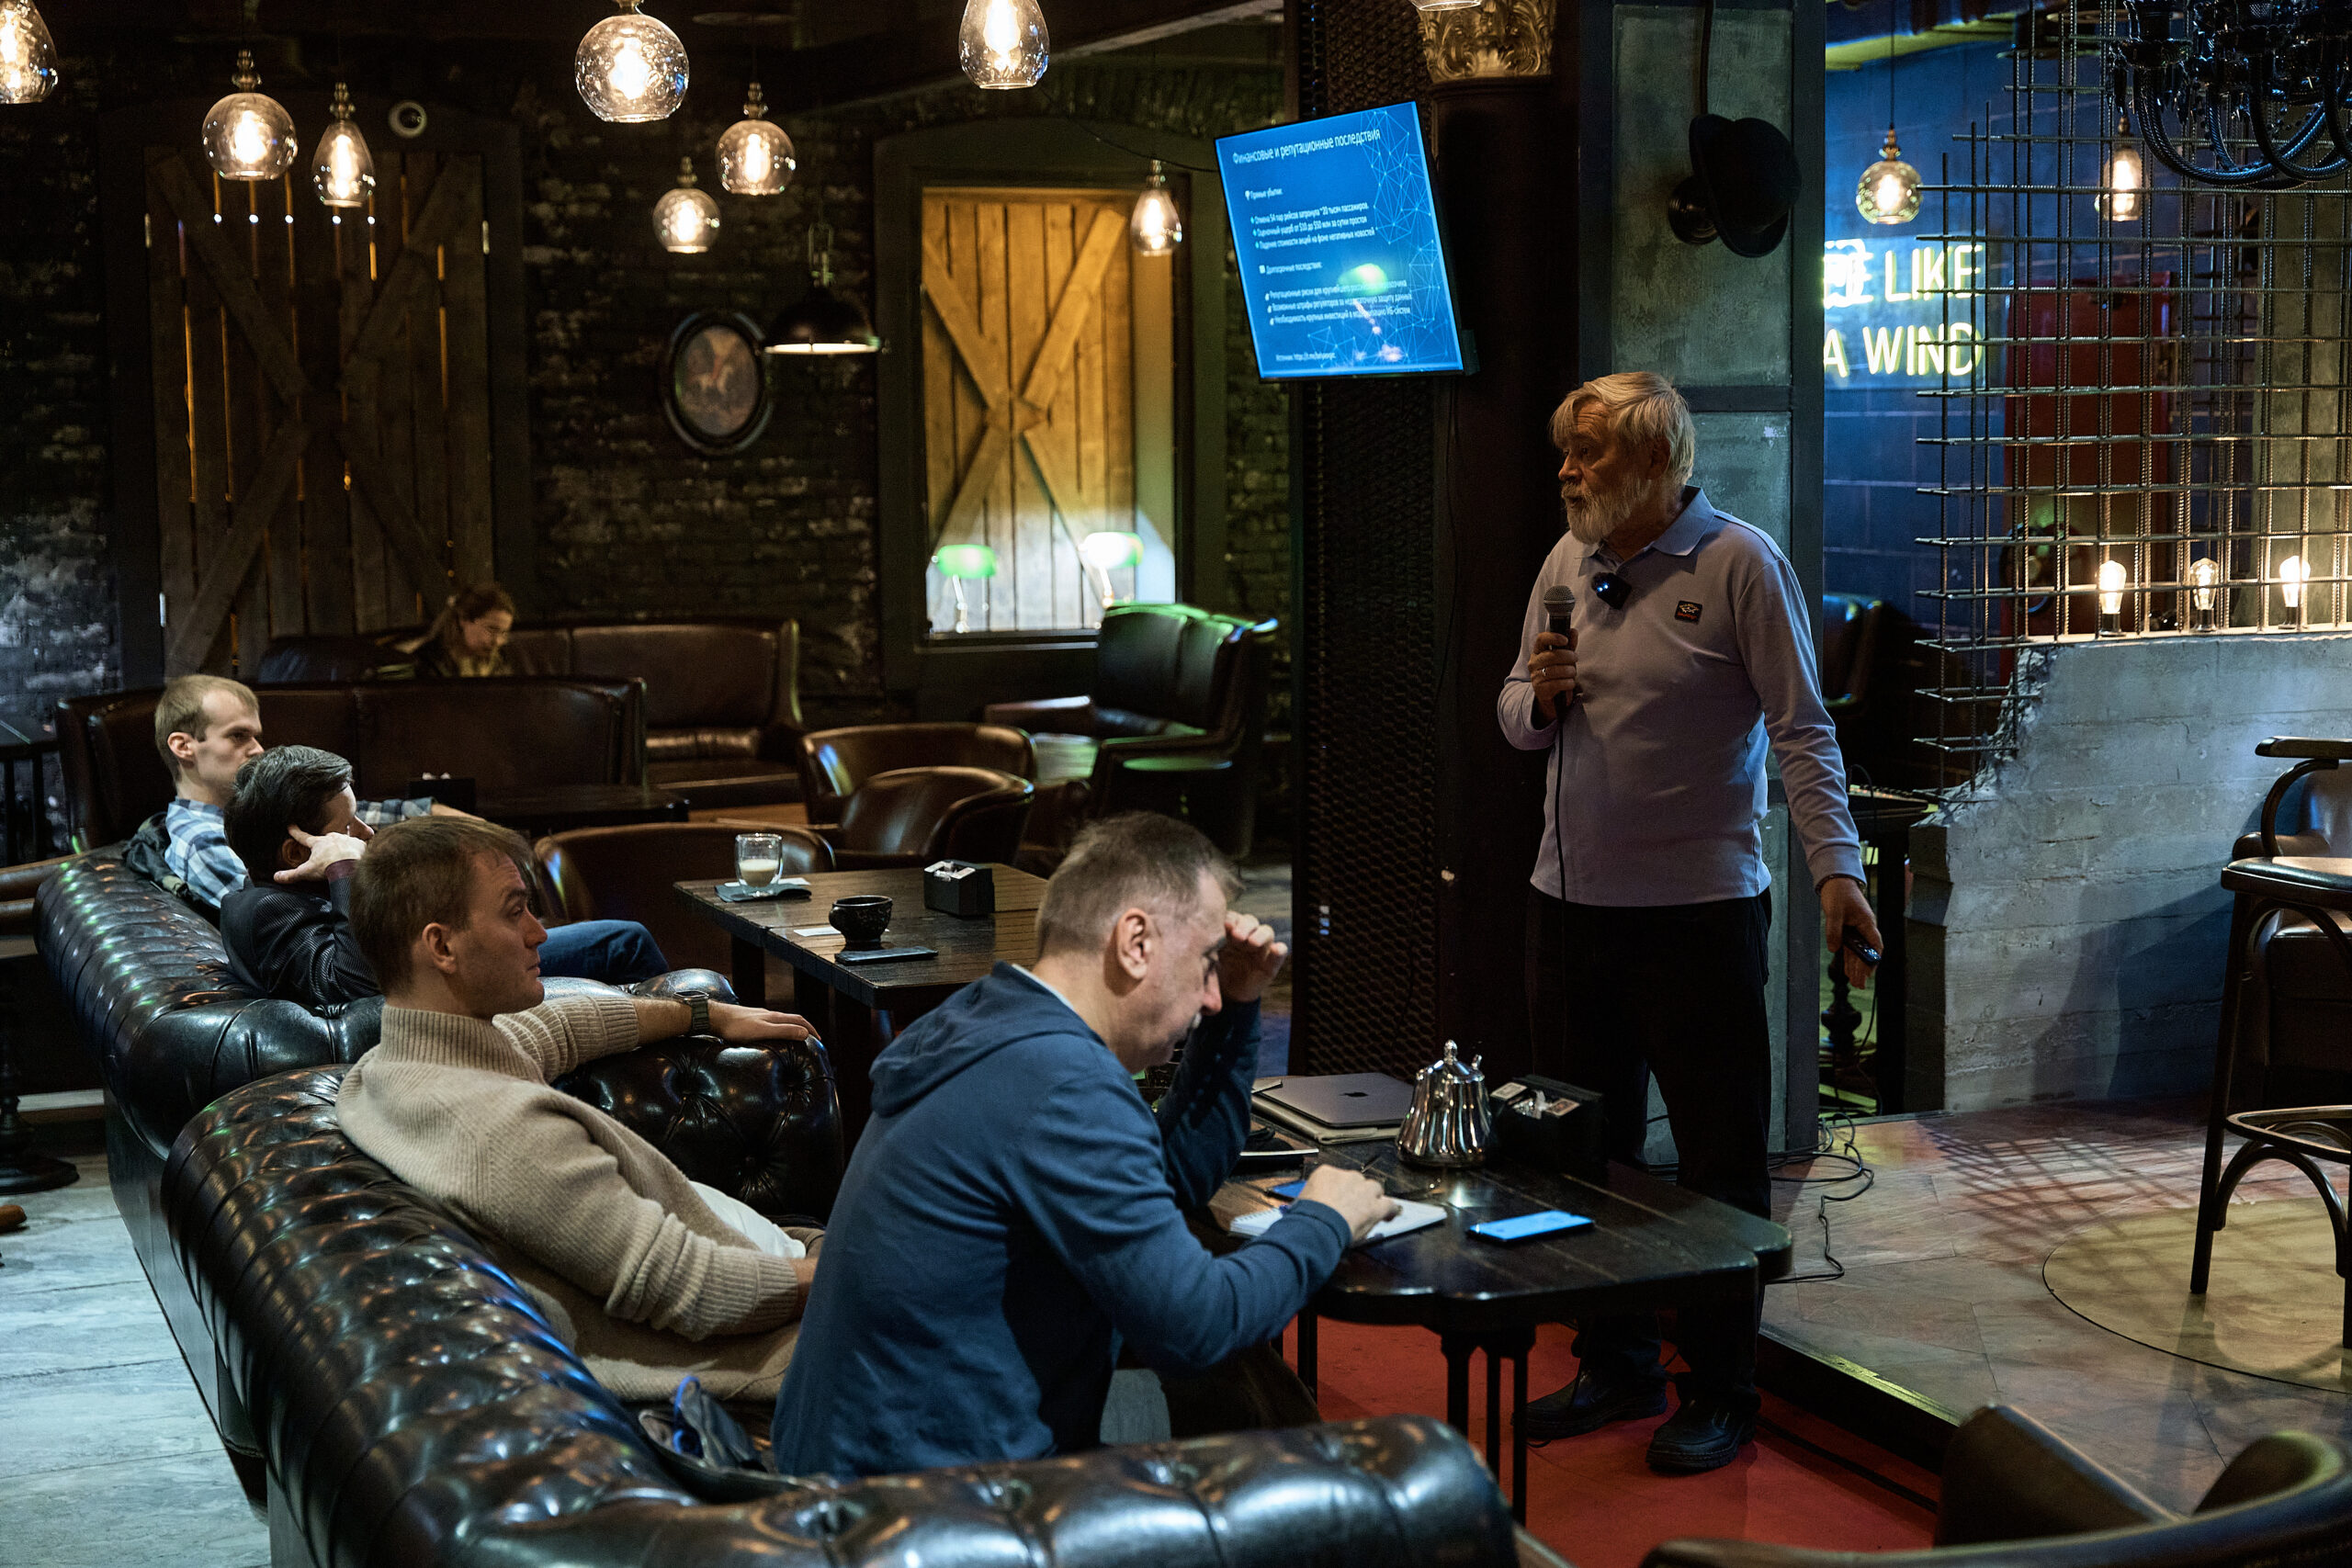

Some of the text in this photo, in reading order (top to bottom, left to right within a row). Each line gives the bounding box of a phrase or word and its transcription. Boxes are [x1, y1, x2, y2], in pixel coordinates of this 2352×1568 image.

[1232, 129, 1381, 164] Финансовые и репутационные последствия
[1884, 244, 1984, 303] LIKE
[1824, 322, 1982, 378] A WIND
